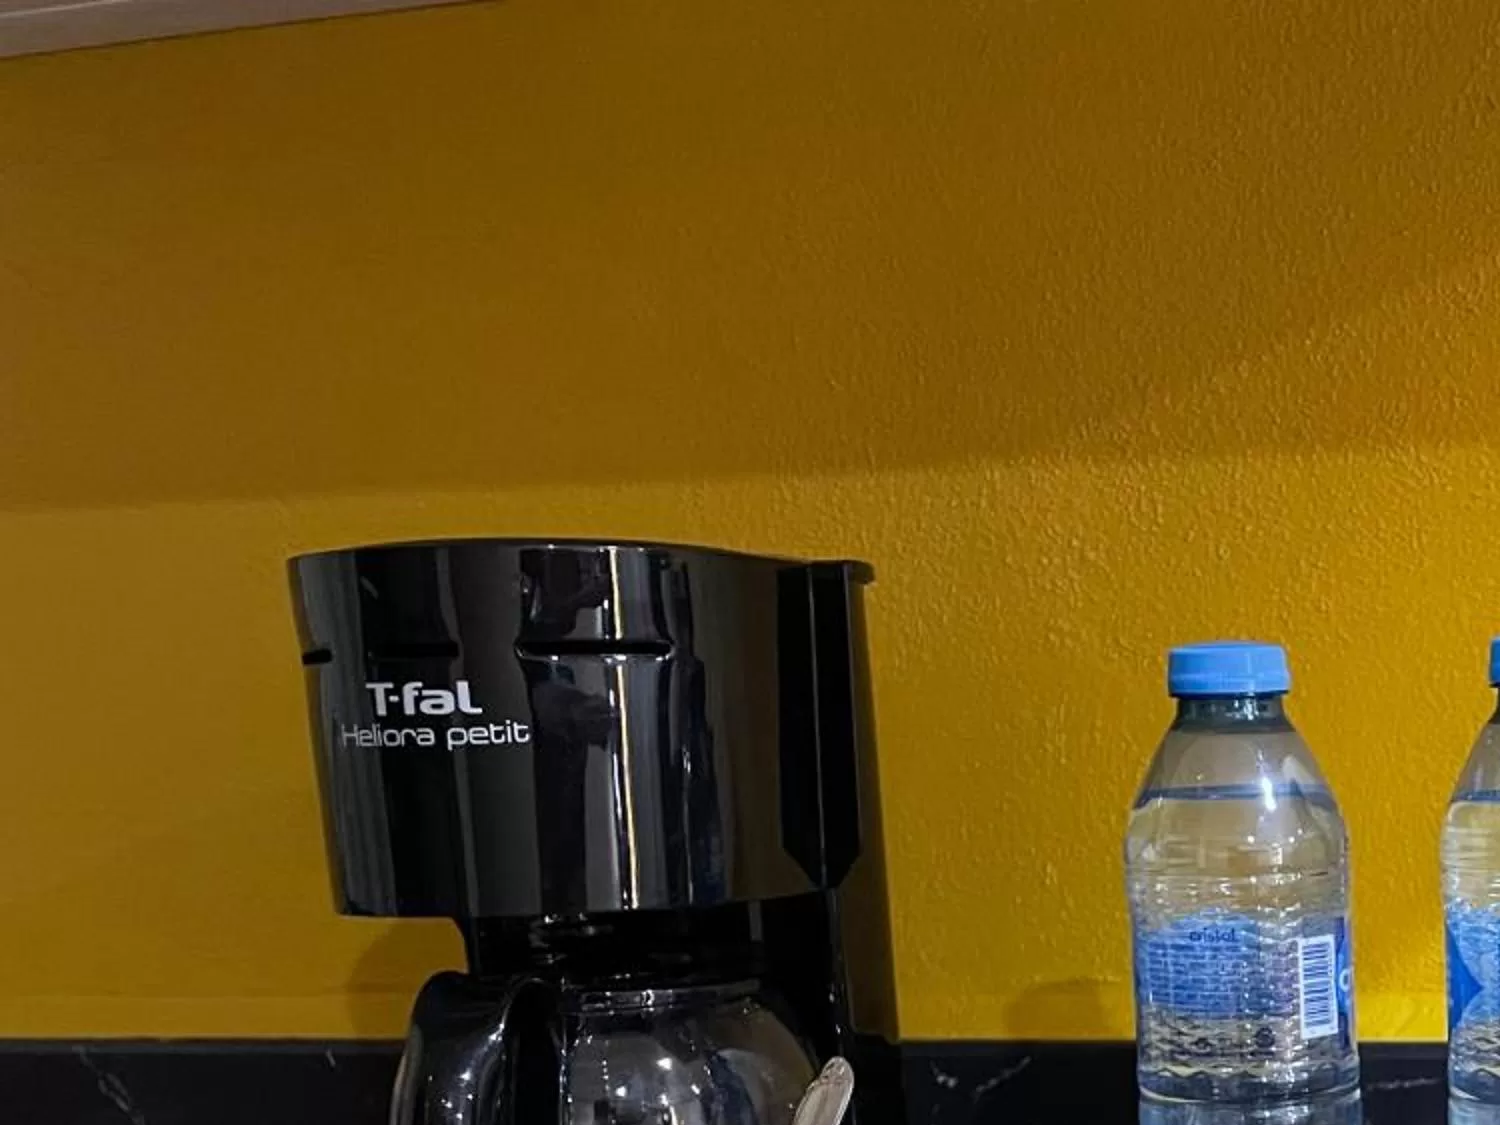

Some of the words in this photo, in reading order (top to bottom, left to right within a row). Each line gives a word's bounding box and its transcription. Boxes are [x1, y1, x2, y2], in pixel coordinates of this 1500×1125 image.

[365, 679, 483, 717] T-fal
[341, 723, 436, 748] Heliora
[447, 719, 531, 751] petit
